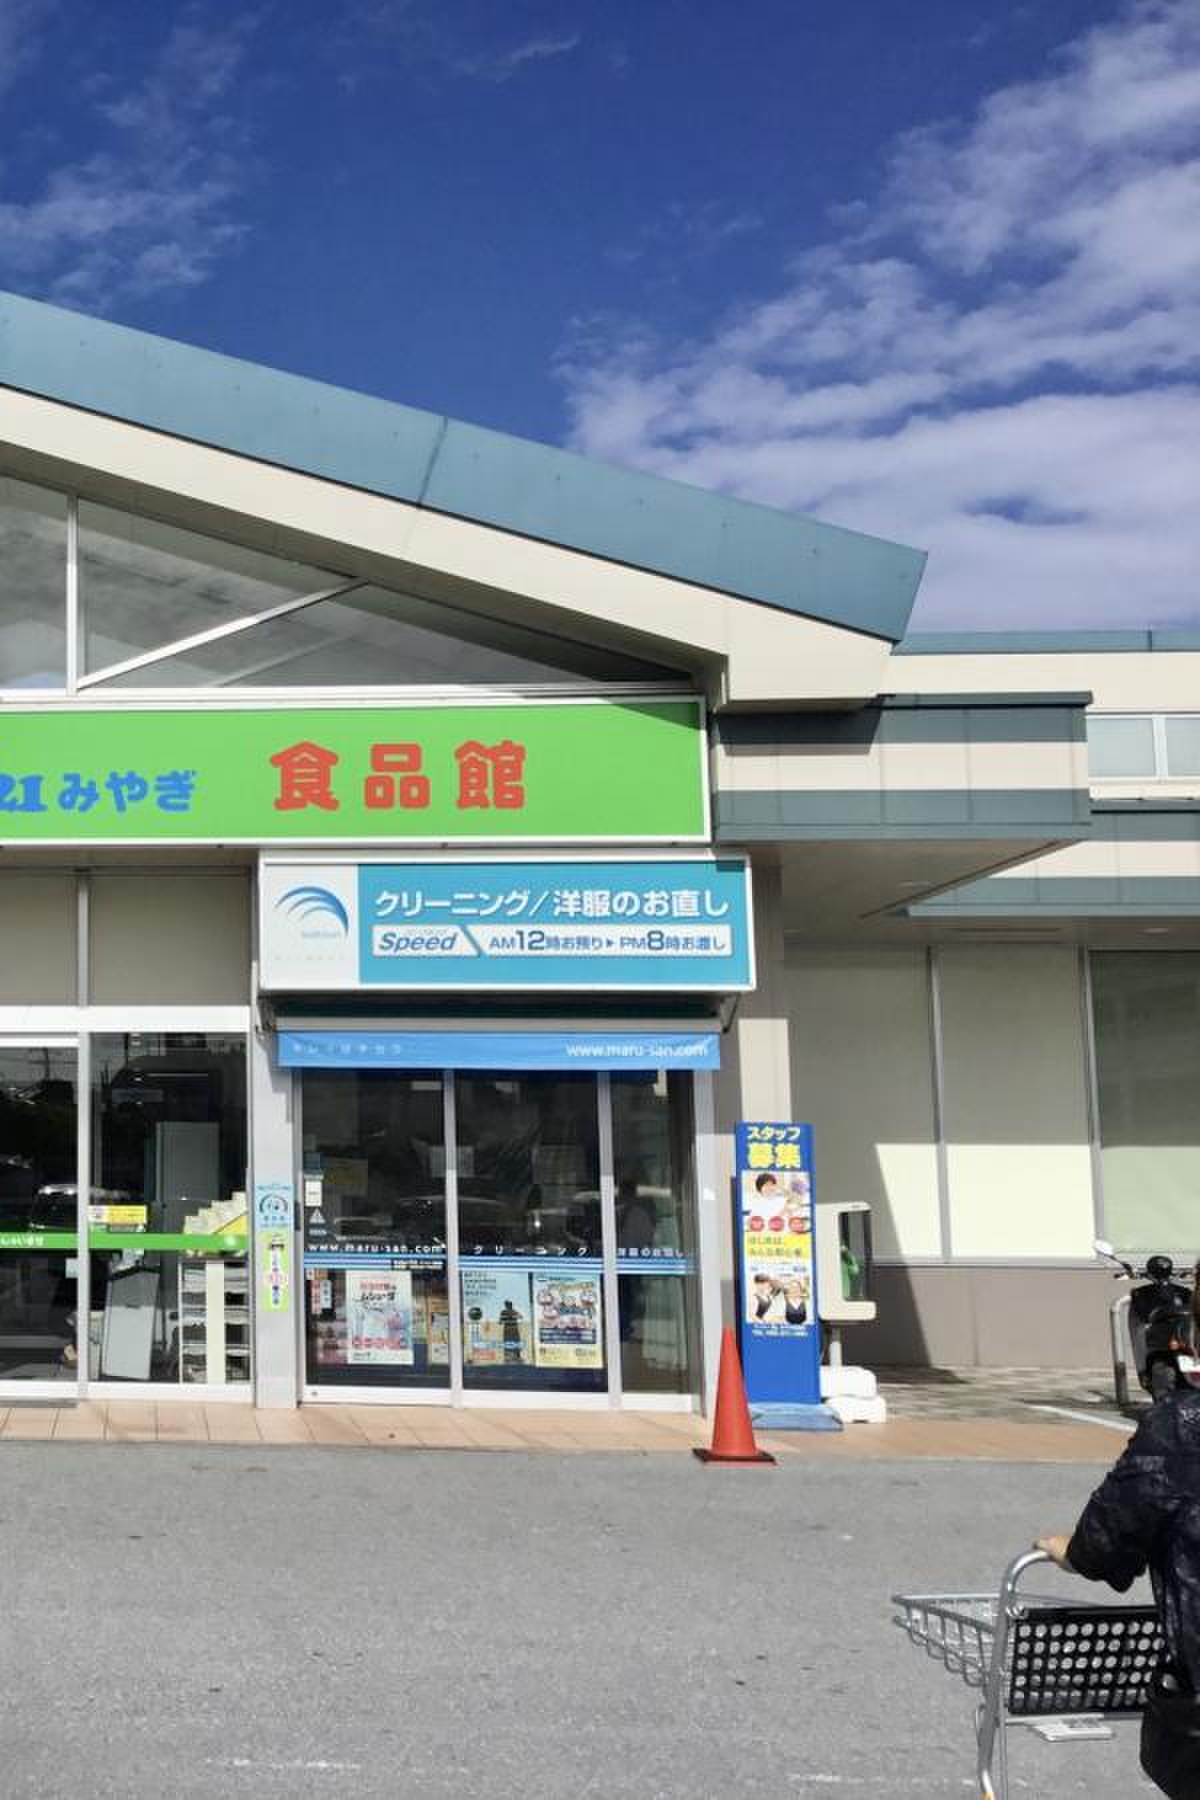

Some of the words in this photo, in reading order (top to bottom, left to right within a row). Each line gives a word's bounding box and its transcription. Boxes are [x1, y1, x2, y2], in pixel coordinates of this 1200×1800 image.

[269, 740, 527, 811] 食品館
[379, 931, 457, 953] Speed
[747, 1126, 801, 1141] スタッフ
[747, 1143, 801, 1169] 募集
